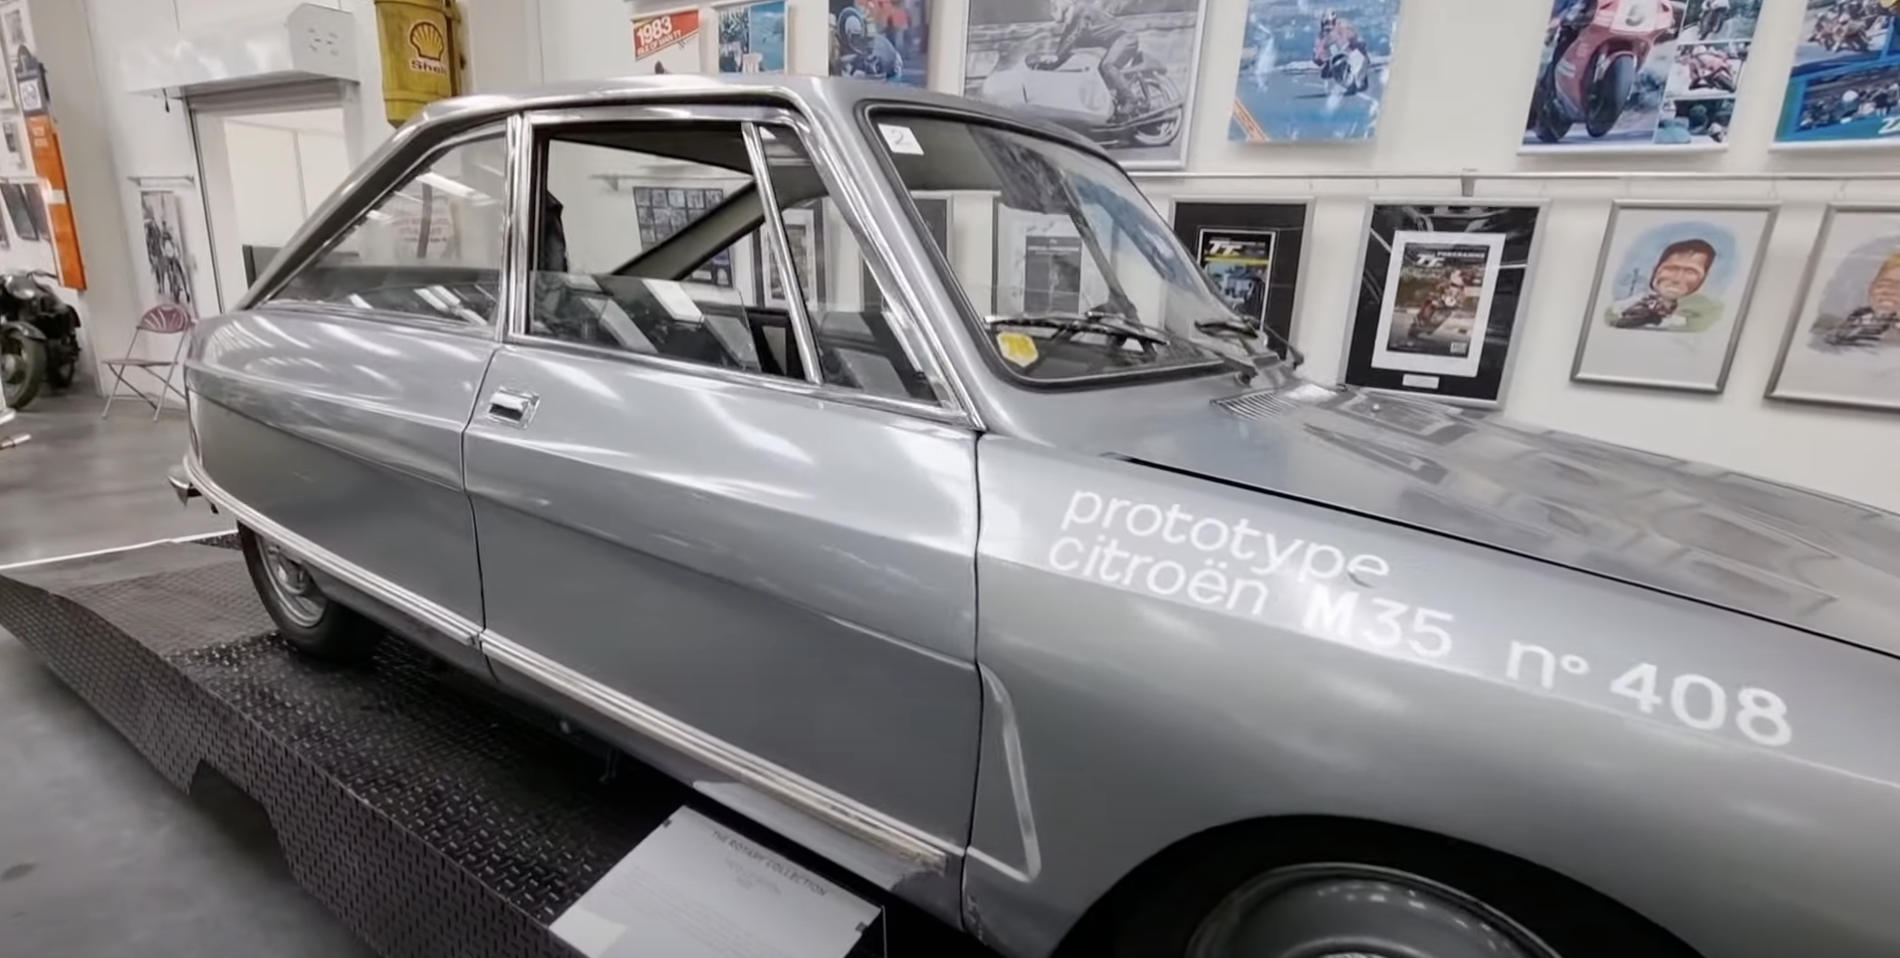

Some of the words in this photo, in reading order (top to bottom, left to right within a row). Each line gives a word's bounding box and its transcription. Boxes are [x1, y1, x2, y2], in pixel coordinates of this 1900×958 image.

[636, 15, 673, 46] 1983
[1059, 490, 1390, 585] prototype
[1049, 534, 1269, 616] citroën
[1609, 662, 1793, 747] 408
[729, 839, 765, 862] ROTARY
[765, 859, 828, 897] COLLECTION
